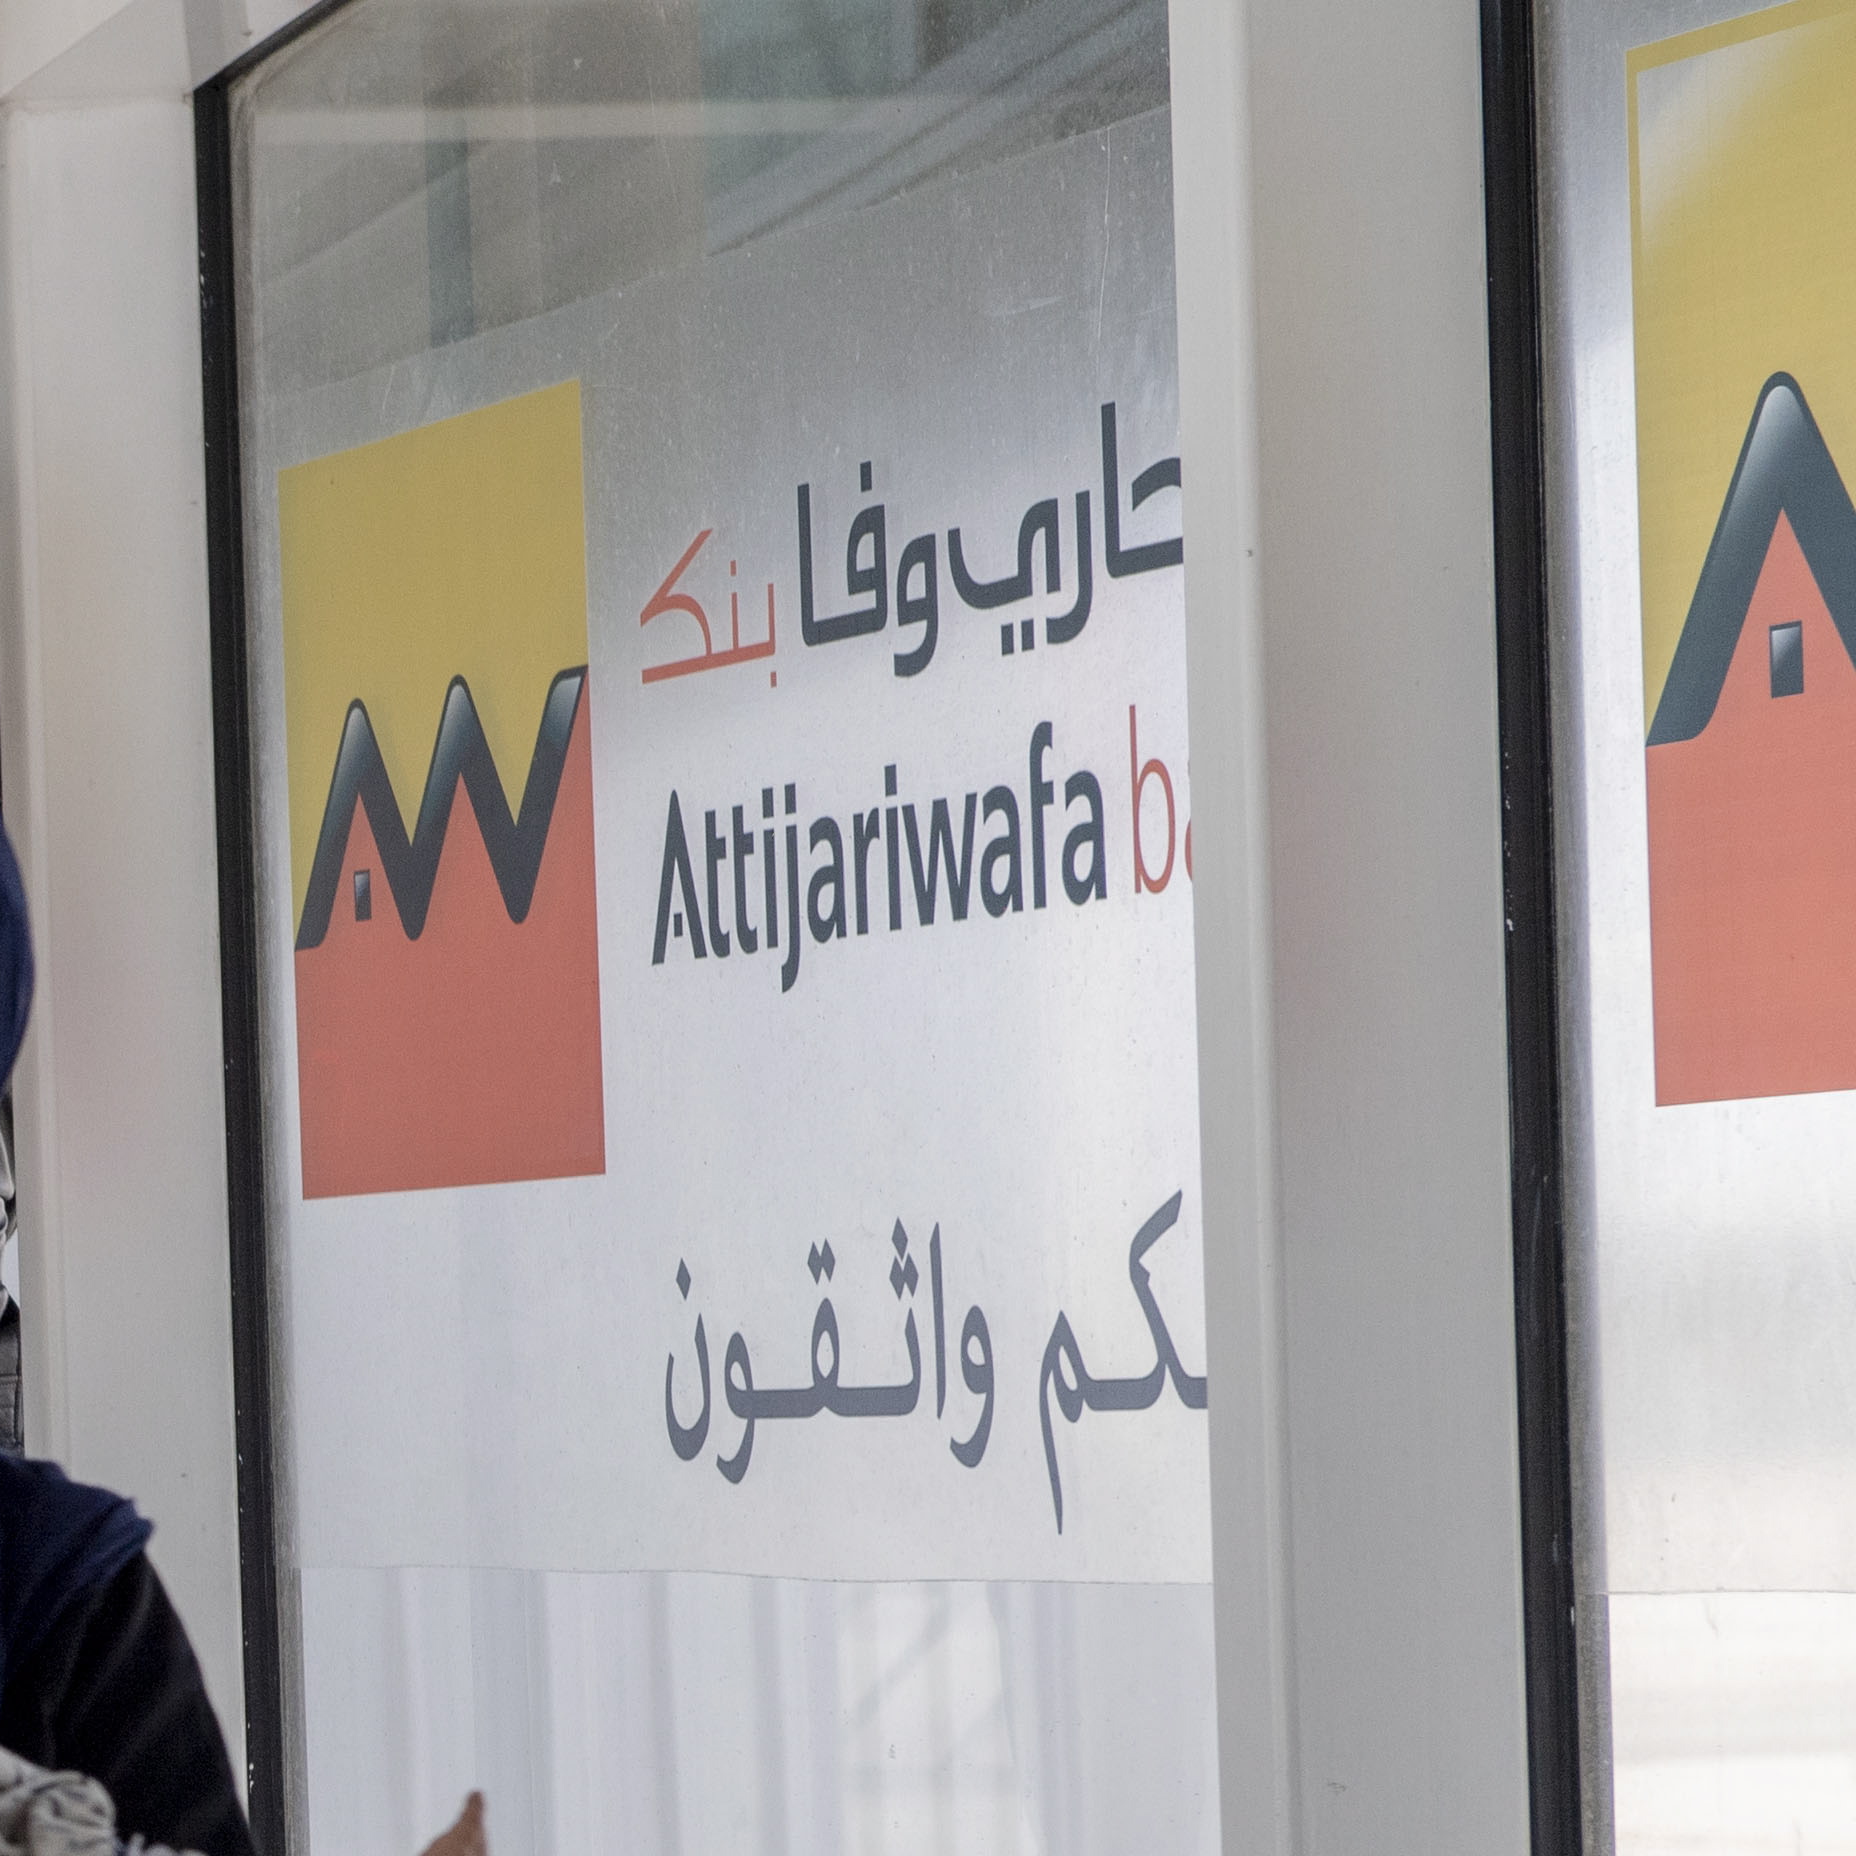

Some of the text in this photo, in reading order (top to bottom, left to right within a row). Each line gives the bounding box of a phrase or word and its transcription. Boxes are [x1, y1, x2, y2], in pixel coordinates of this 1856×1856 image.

[639, 527, 778, 689] بنك
[651, 703, 1193, 994] Attijariwafa b
[664, 1189, 1208, 1535] كم واثقون
